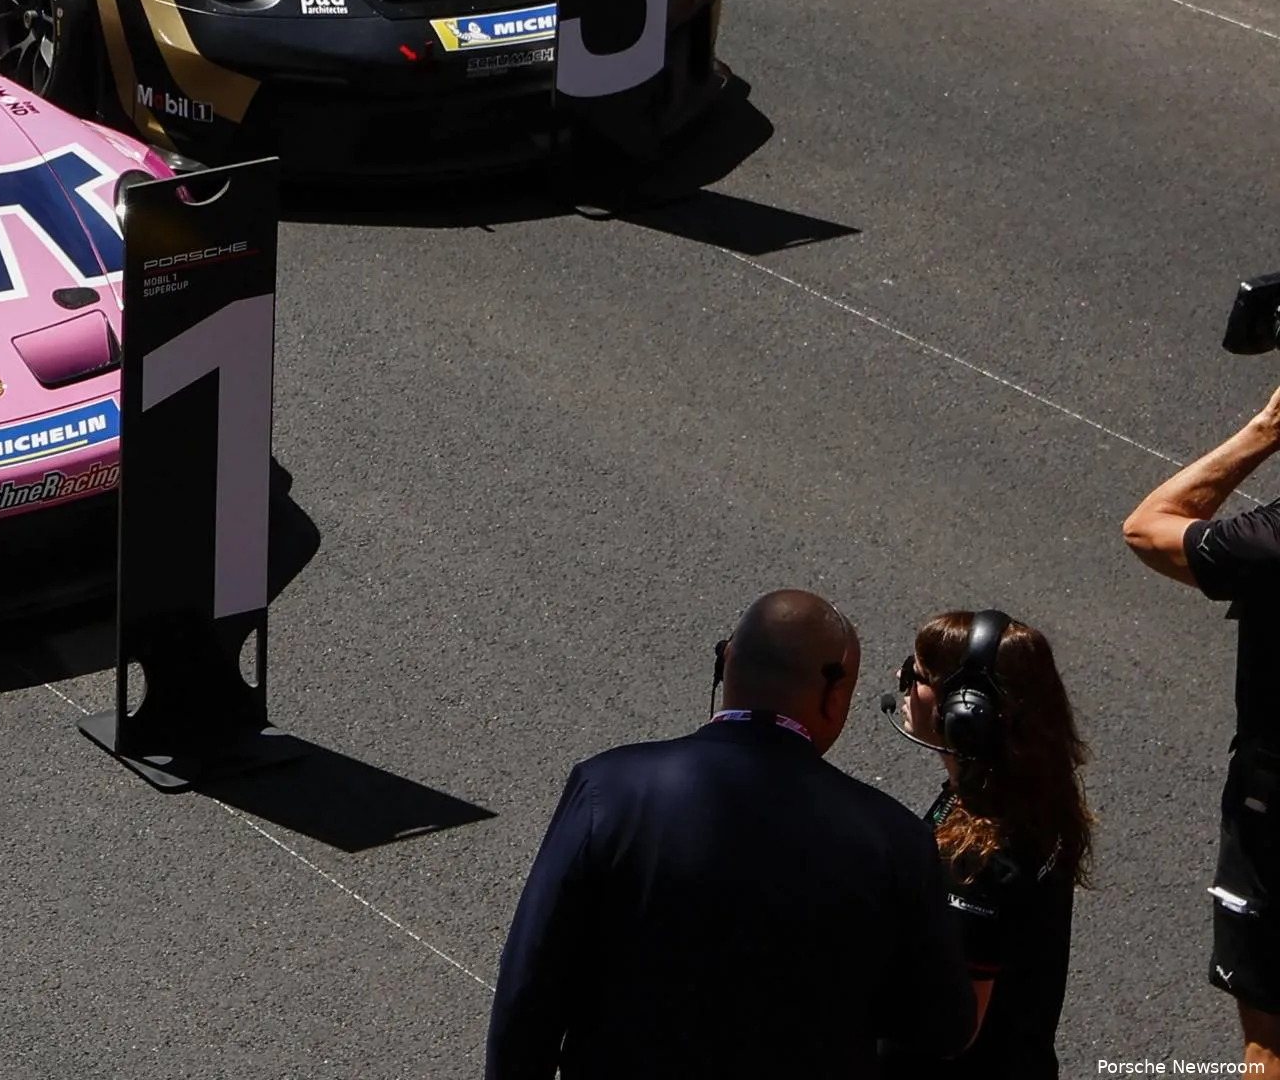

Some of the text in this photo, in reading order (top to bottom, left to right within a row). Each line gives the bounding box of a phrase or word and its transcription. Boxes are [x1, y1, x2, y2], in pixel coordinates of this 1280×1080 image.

[307, 5, 349, 15] architectes
[137, 83, 189, 118] Mobil
[143, 241, 248, 271] PORSCHE
[143, 275, 172, 288] MOBIL
[143, 281, 189, 297] SUPERCUP
[142, 293, 274, 619] 1
